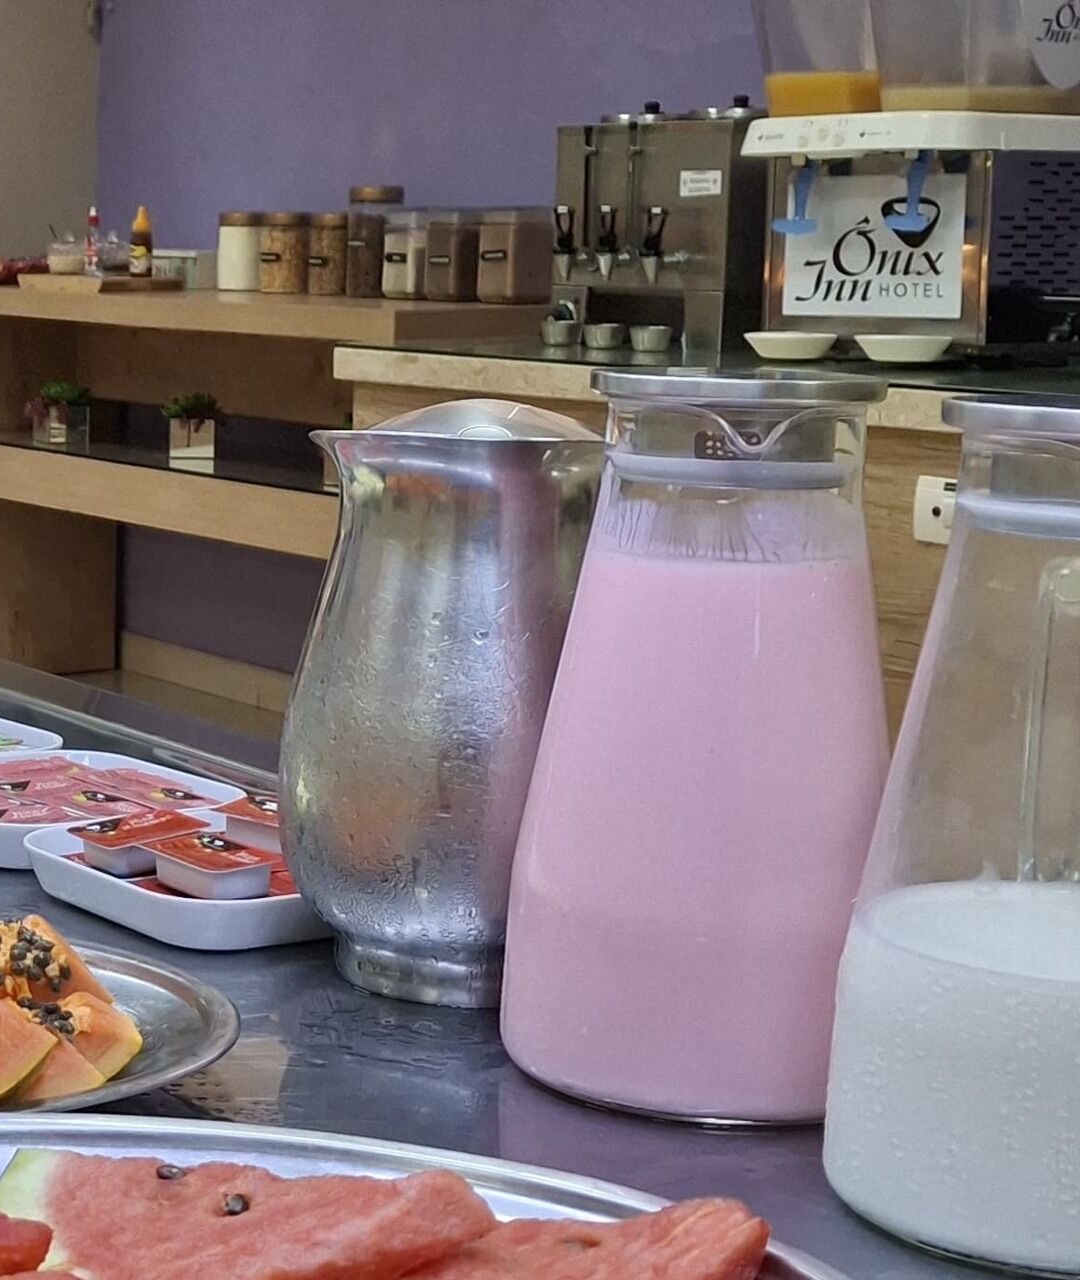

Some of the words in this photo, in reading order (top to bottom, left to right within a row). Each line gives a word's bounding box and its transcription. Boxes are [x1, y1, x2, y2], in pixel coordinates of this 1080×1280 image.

[832, 216, 944, 277] Ônix
[794, 260, 872, 302] Inn
[879, 282, 944, 298] HOTEL
